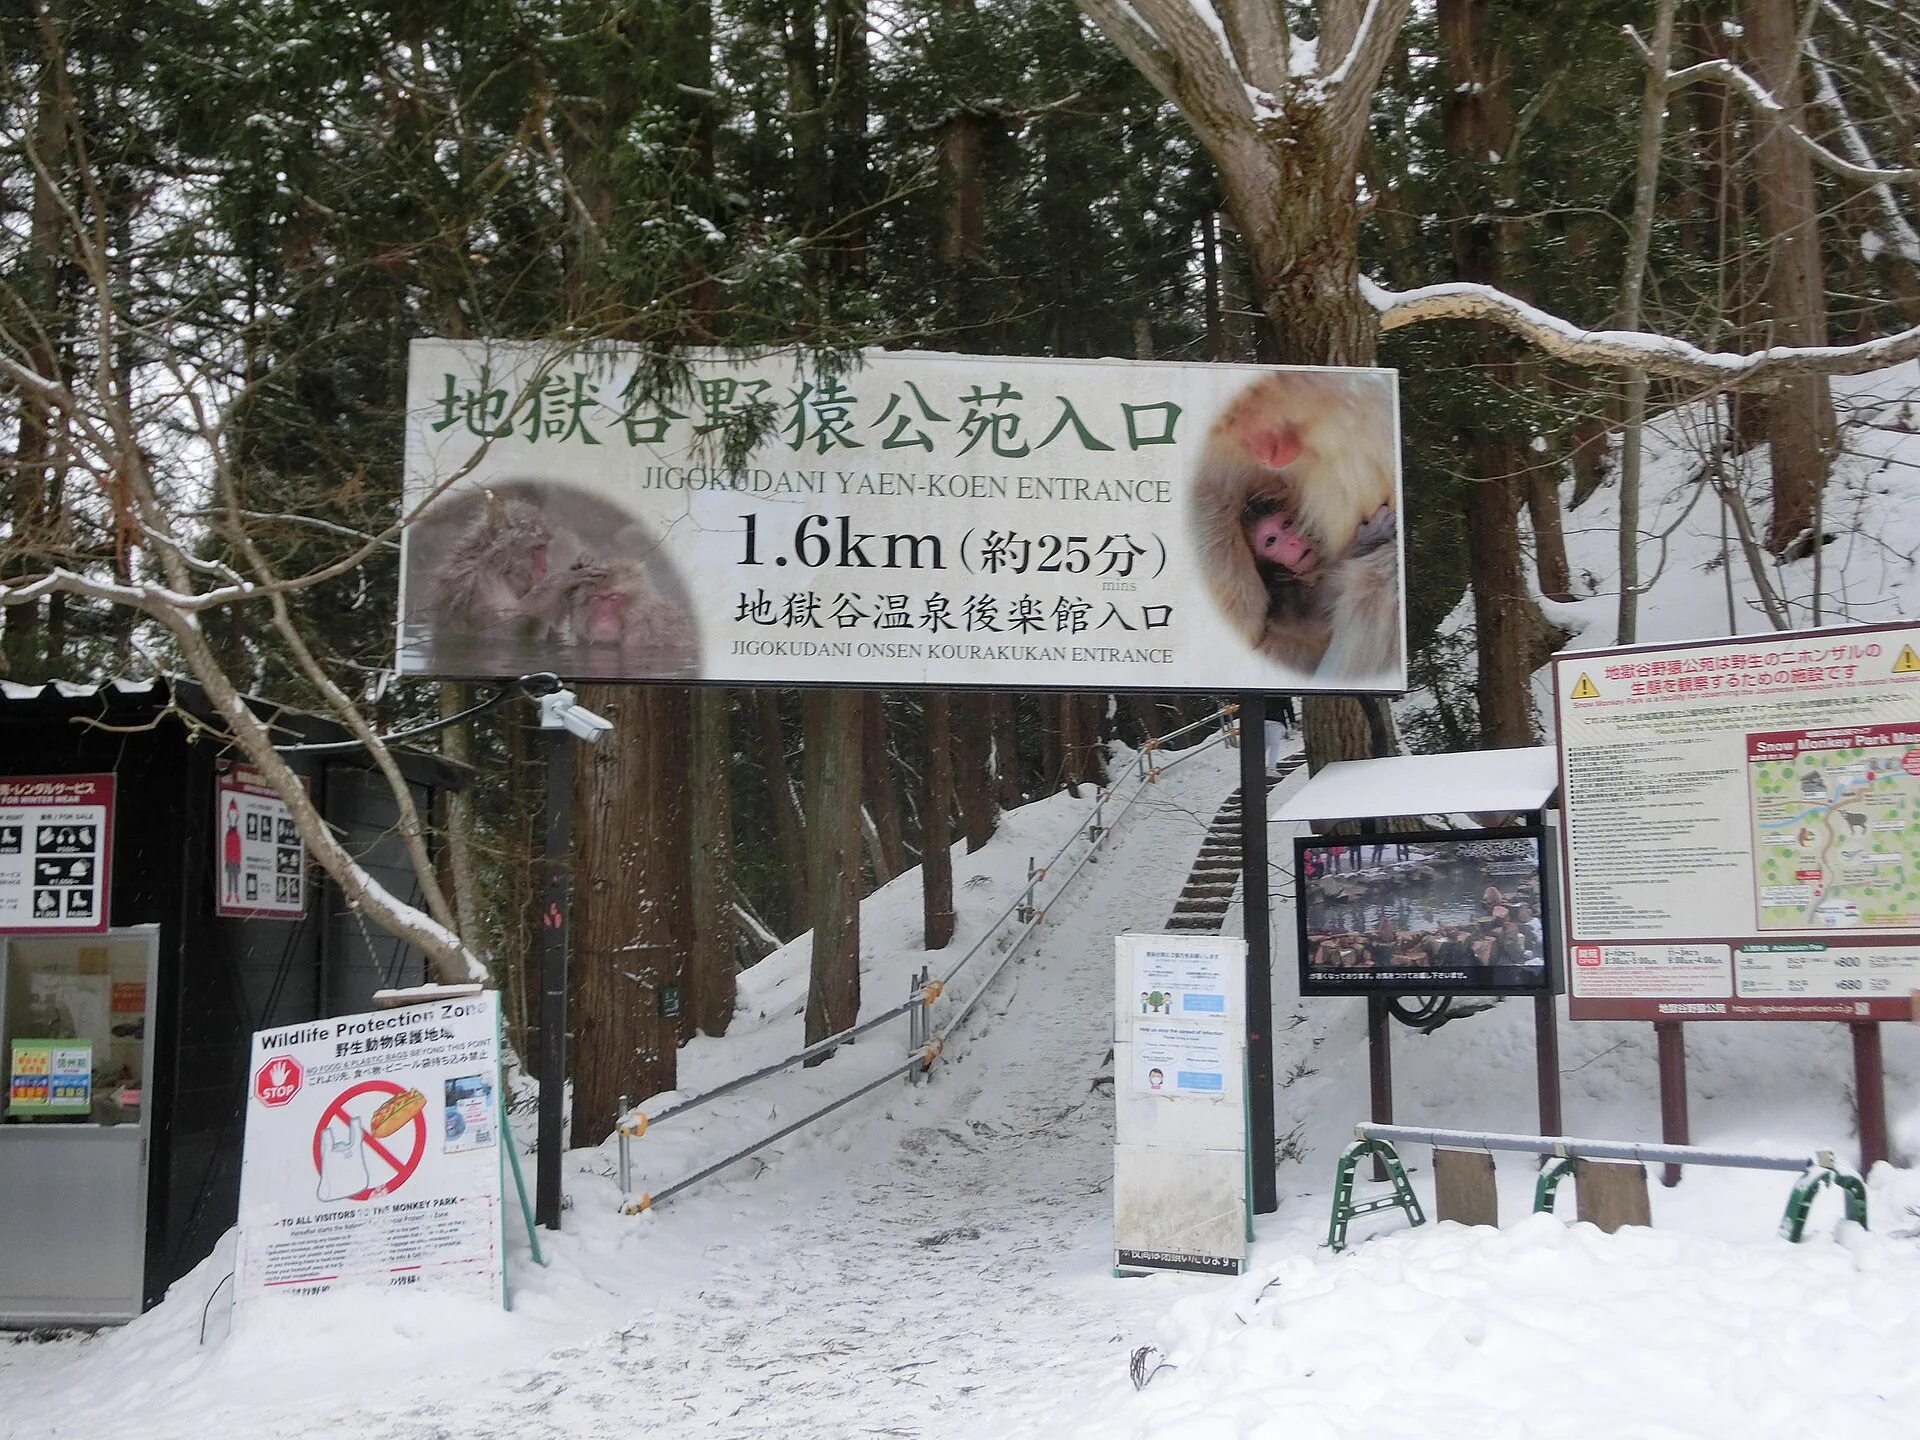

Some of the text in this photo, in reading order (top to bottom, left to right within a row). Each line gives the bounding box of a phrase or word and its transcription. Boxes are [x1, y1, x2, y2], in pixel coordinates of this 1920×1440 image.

[431, 368, 1182, 458] 地獄谷野猿公苑入口
[642, 466, 1171, 503] JIGOKUDANI YAEN-KOEN ENTRANCE
[737, 513, 946, 569] 1.6km
[1102, 579, 1137, 591] mins
[735, 589, 1173, 635] 地獄谷温泉後楽館入口
[731, 640, 1173, 663] JIGOKUDANI ONSEN KOURAKUKAN ENTRANCE
[1631, 664, 1858, 696] 生態を観察するための施設です
[1757, 741, 1795, 752] Snow
[1797, 736, 1852, 749] Monkey
[1855, 734, 1889, 746] Park
[262, 1003, 487, 1049] Wildlife Protection Zone
[351, 1055, 384, 1068] PLASTIC
[410, 1045, 445, 1057] BEYOND
[447, 1042, 465, 1051] THIS
[467, 1038, 491, 1049] POINT
[262, 1085, 294, 1099] STOP
[280, 1219, 293, 1227] TO
[295, 1216, 312, 1225] ALL
[314, 1210, 356, 1222] VISITORS
[393, 1201, 430, 1213] MONKEY
